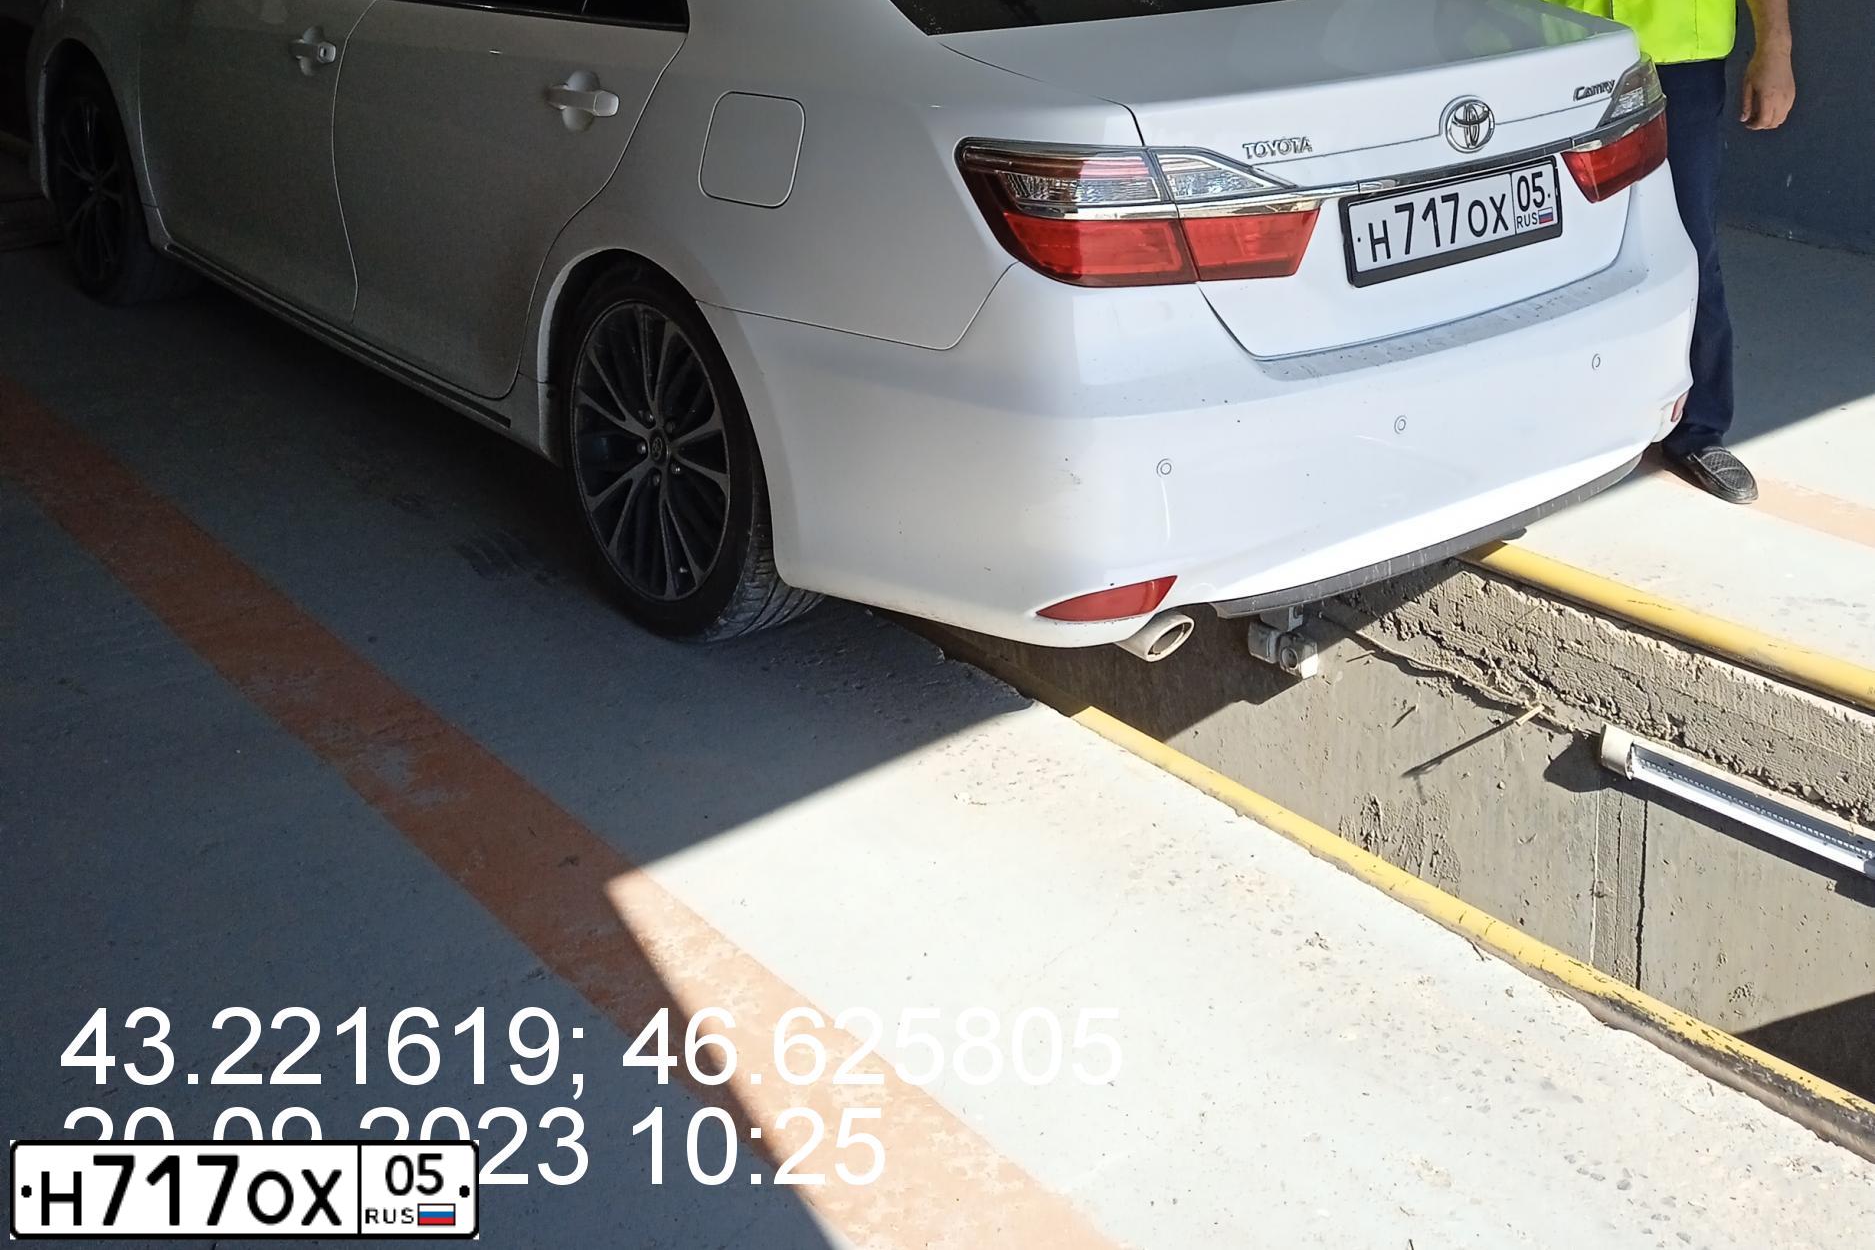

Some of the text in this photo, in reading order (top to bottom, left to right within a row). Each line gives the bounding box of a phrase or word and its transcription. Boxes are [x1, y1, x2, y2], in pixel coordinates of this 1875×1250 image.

[1242, 136, 1313, 159] TOYOTA
[1516, 170, 1545, 212] 05
[1516, 212, 1539, 229] RUS
